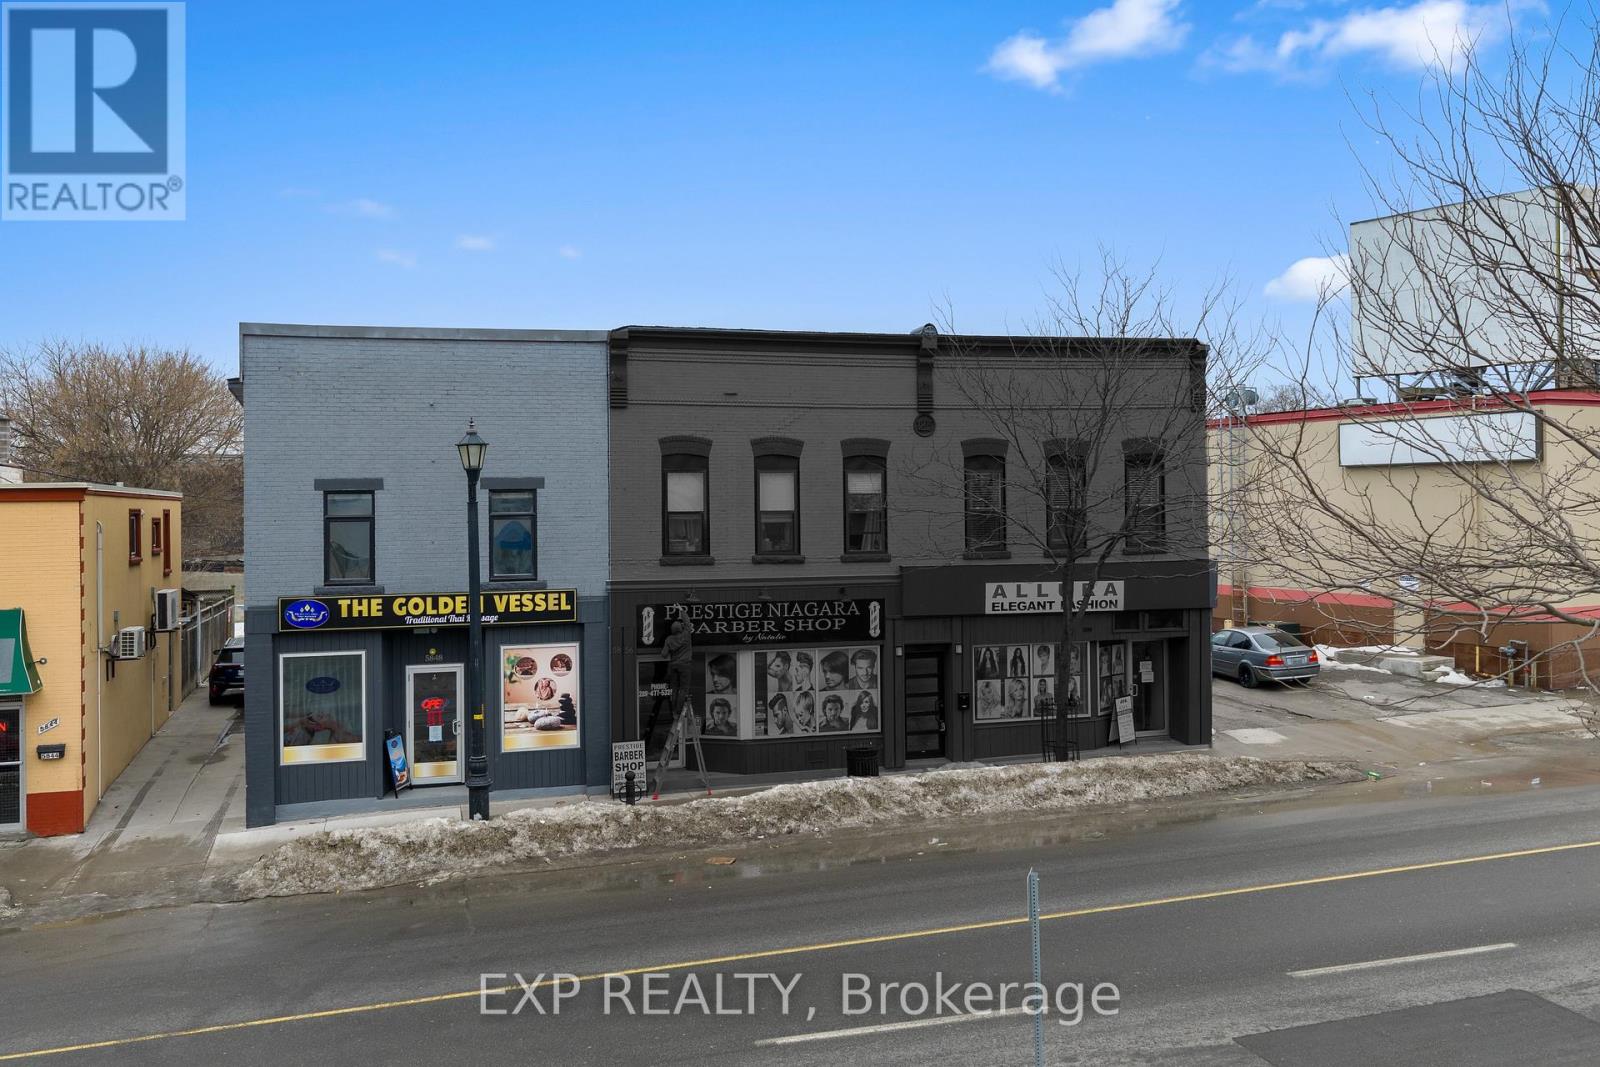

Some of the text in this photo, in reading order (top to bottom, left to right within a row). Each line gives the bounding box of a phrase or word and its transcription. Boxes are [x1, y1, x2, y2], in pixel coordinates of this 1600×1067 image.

[991, 582, 1118, 599] ALLRA
[338, 598, 383, 617] THE
[494, 592, 571, 613] VESSEL
[664, 601, 860, 621] PRESTIGE NIAGARA
[991, 600, 1055, 612] ELEGANT
[405, 613, 499, 625] Traditional Thai sage
[784, 618, 847, 632] SHOP
[614, 750, 644, 761] BARBER
[615, 761, 644, 772] SHOP
